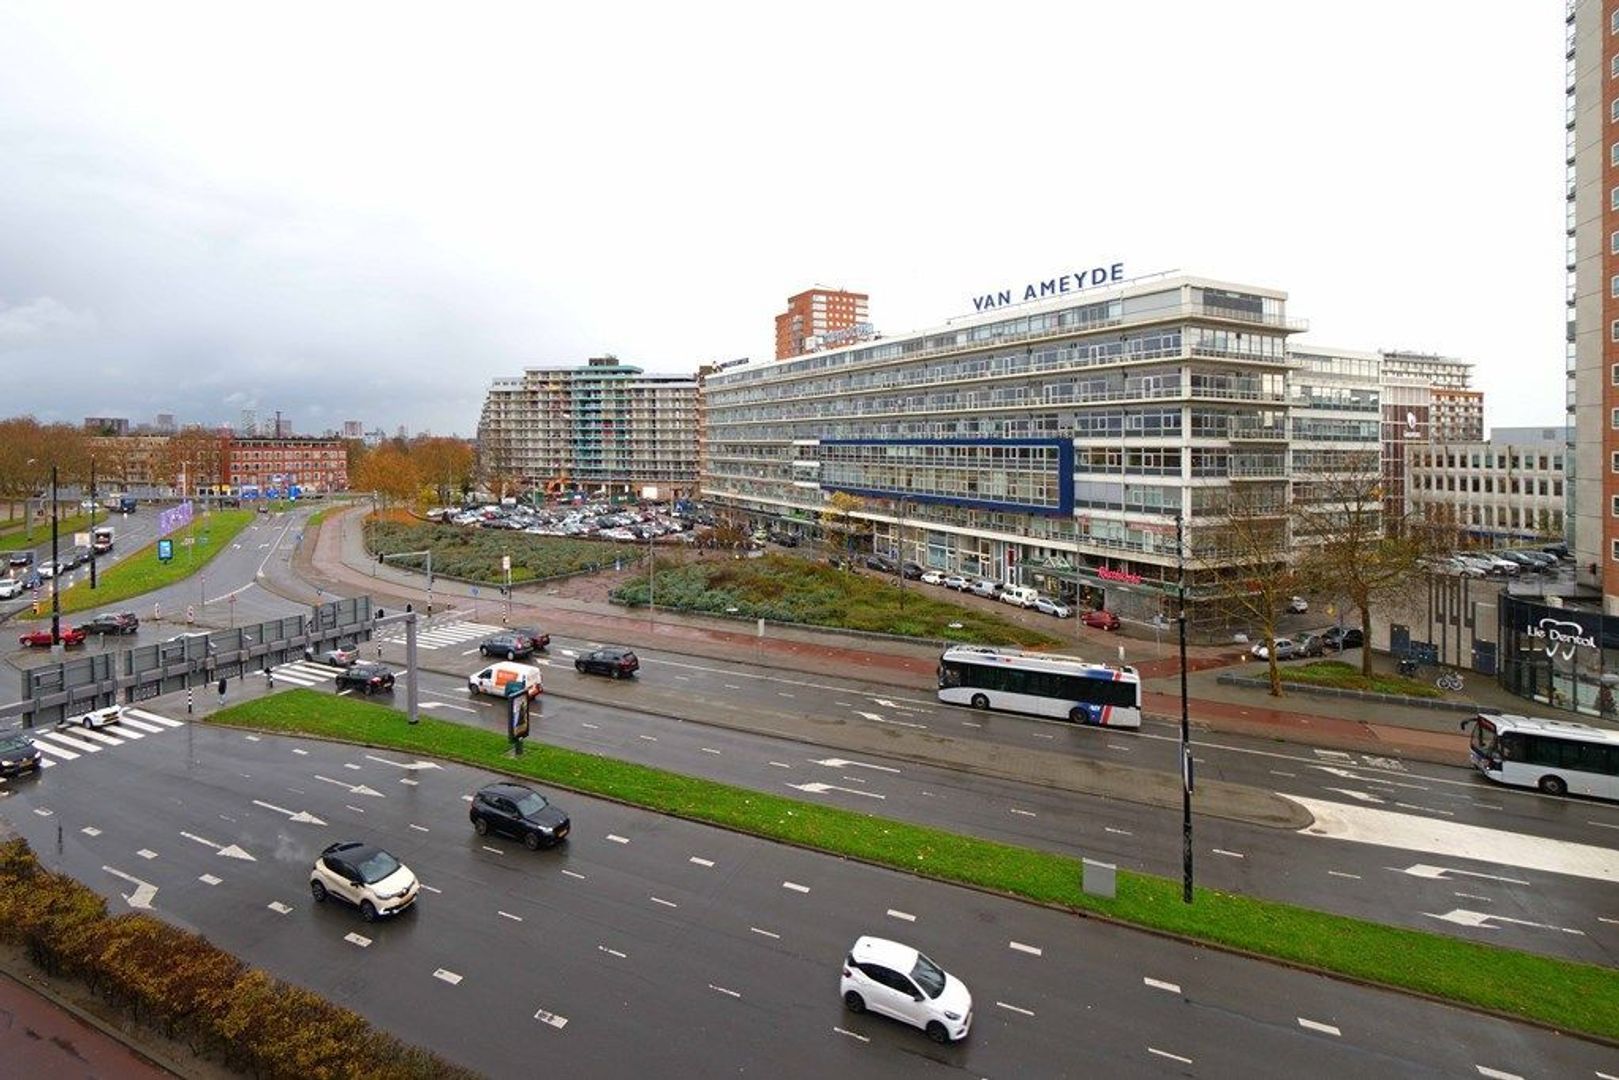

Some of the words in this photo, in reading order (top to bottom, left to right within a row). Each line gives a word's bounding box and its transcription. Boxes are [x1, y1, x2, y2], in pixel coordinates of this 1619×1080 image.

[973, 290, 1011, 311] VAN
[1023, 262, 1124, 301] AMEYDE
[1549, 629, 1597, 648] Dental
